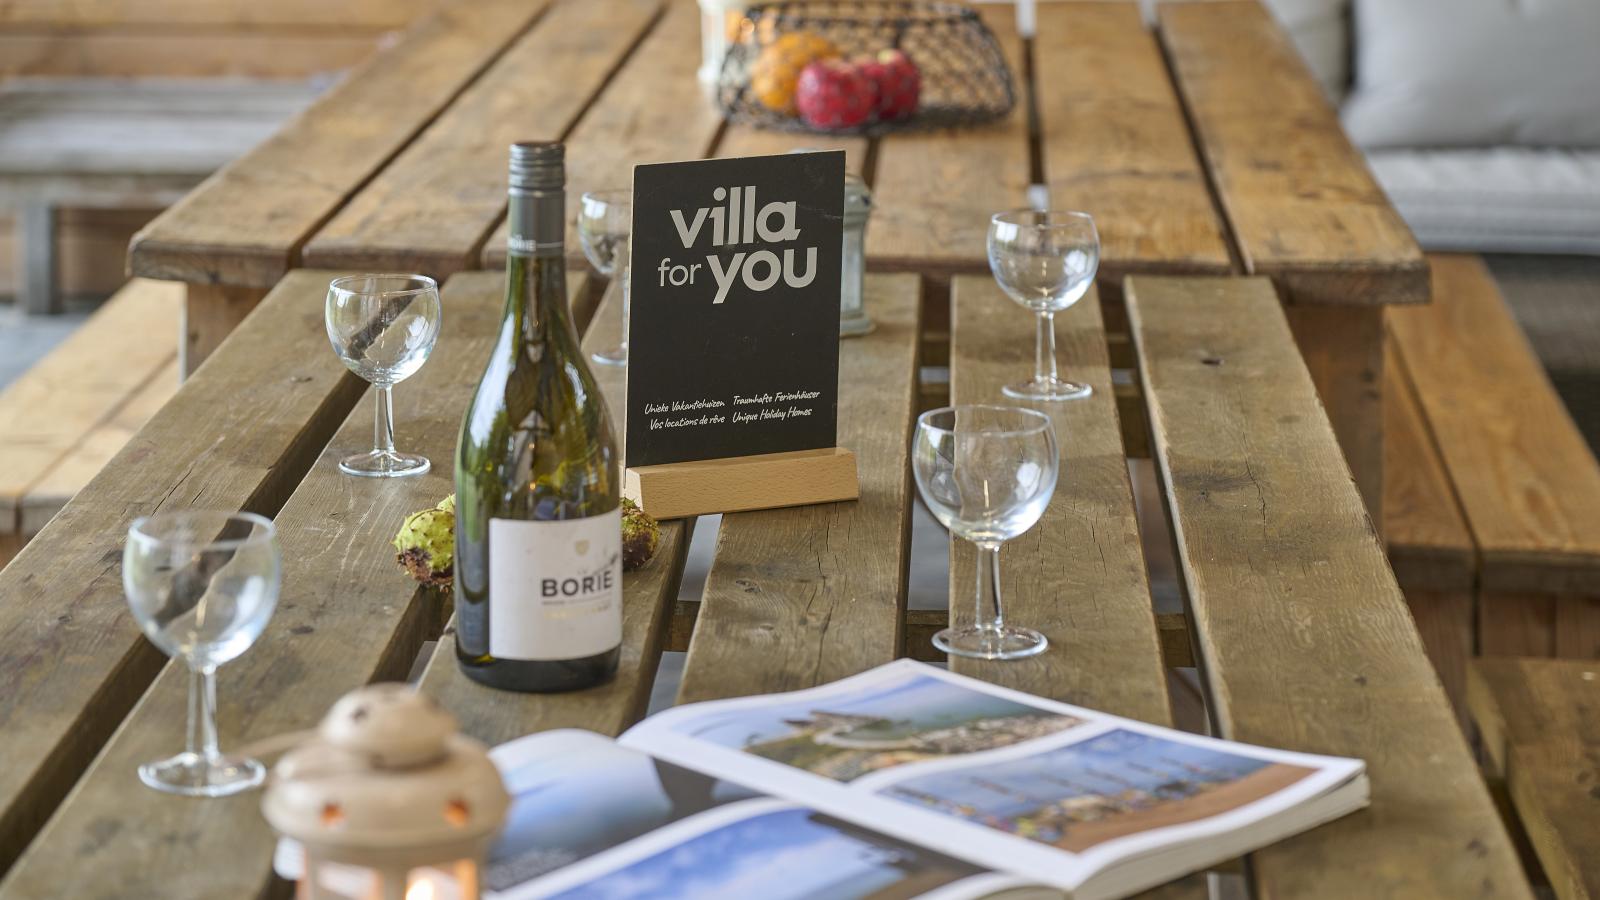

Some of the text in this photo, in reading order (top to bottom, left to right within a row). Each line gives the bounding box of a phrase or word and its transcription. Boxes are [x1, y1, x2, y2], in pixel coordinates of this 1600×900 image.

[669, 185, 801, 249] villa
[657, 246, 818, 305] for you
[644, 398, 726, 415] Unieke Vakantiehuizen
[733, 389, 821, 406] Traumhafte Ferienhäuser
[650, 414, 726, 431] Vos locations de rêve
[732, 406, 813, 424] Unique Holiday Homes
[541, 569, 613, 598] BORIE
